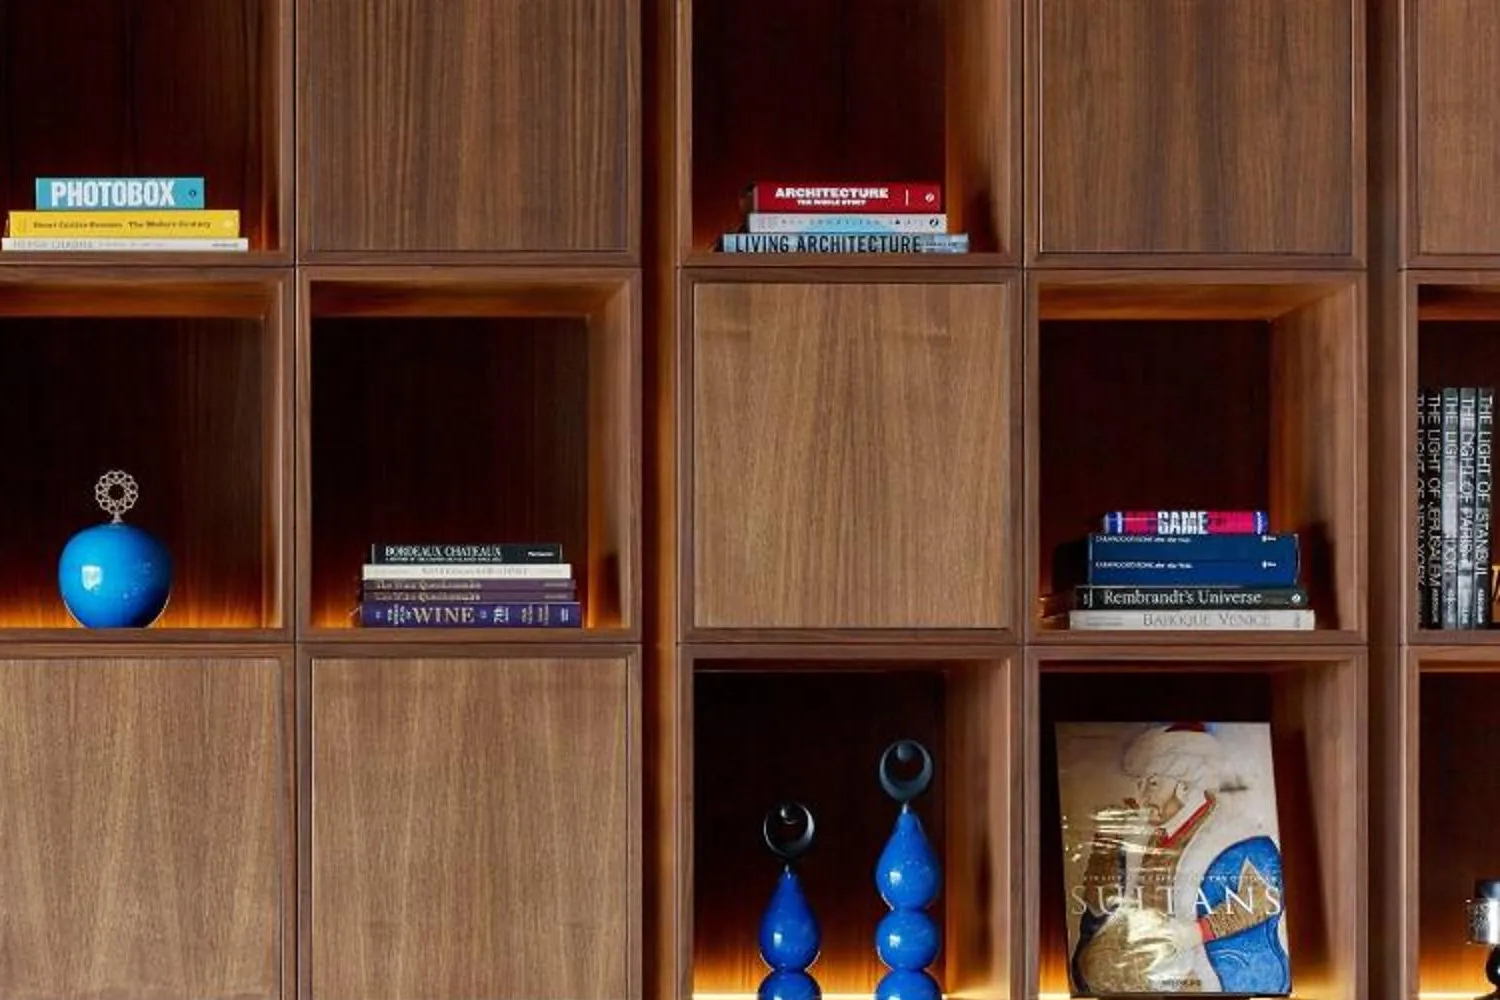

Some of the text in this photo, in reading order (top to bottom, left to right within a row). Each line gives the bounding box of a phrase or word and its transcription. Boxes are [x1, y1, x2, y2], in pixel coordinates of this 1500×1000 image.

[50, 180, 176, 207] PHOTOBOX
[774, 187, 889, 199] ARCHITECTURE
[735, 235, 921, 253] LIVING ARCHITECTURE
[1444, 395, 1457, 425] THE
[1461, 397, 1475, 427] THE
[1427, 393, 1441, 587] THE LIGHT OF JERUSALEM
[1475, 395, 1493, 578] THE LIGHT OF ISTANBUL
[1157, 511, 1209, 535] GAME
[1103, 589, 1262, 605] Rembrandt's Universe
[411, 607, 476, 623] WINE
